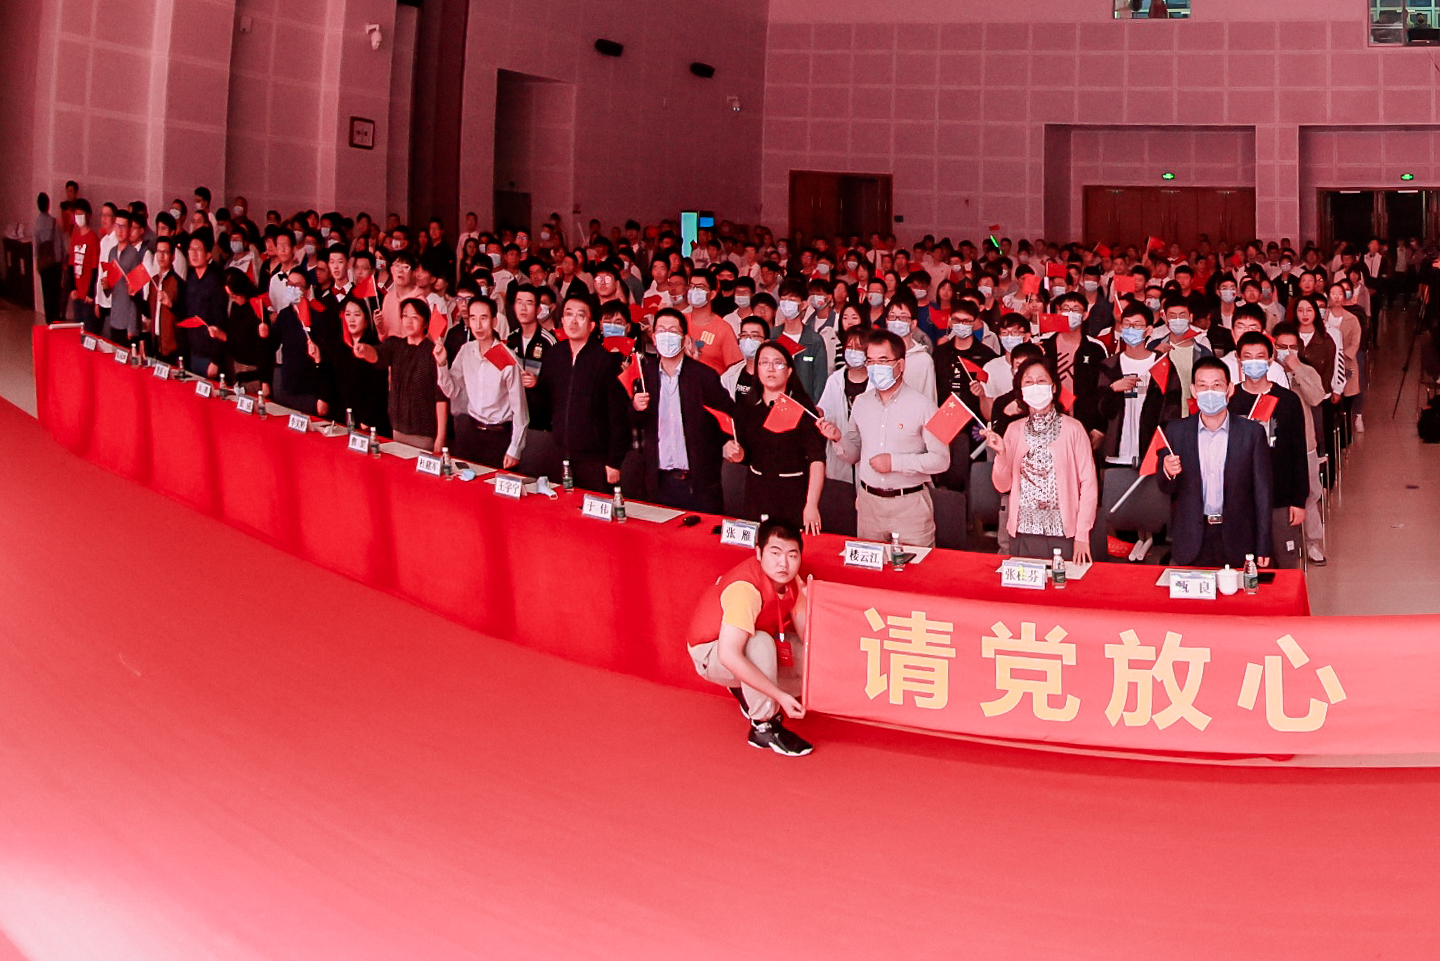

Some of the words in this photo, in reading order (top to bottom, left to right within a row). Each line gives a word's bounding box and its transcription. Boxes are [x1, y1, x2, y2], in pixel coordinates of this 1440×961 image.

[726, 526, 752, 542] 张雁
[849, 548, 880, 564] 楼云江
[1005, 567, 1040, 583] 张桂芬
[860, 607, 1346, 732] 请党放心
